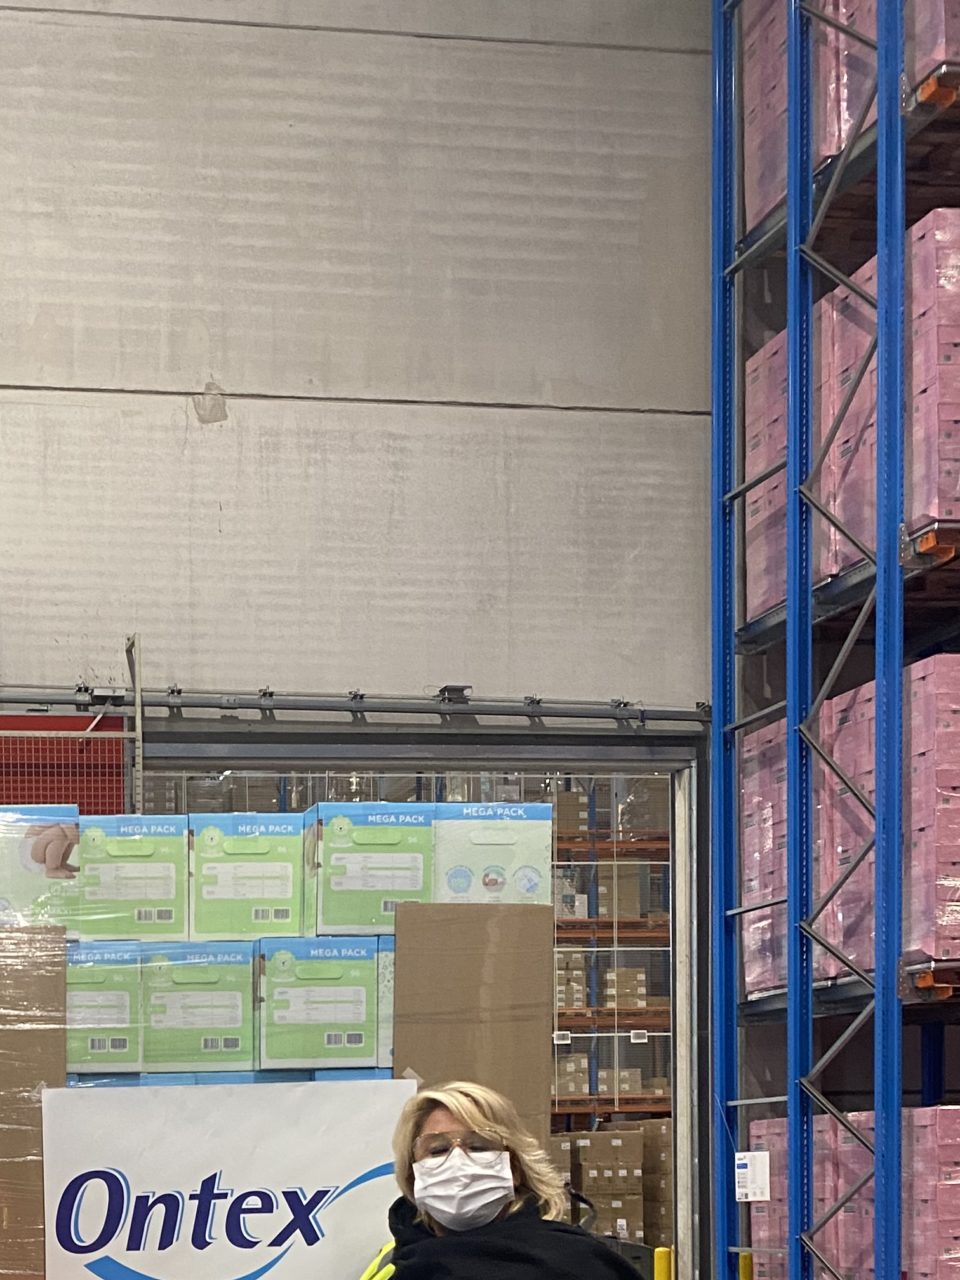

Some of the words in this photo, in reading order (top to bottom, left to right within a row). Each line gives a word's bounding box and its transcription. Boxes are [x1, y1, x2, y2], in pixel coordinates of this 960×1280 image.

[463, 807, 492, 816] MEGA
[497, 807, 525, 816] PACK
[368, 814, 396, 823] MEGA
[399, 814, 425, 823] PACK
[120, 825, 146, 834] MEGA
[149, 825, 176, 833] PACK
[238, 825, 266, 834] MEGA
[269, 825, 294, 833] PACK
[73, 953, 101, 961] MEGA
[104, 952, 131, 961] PACK
[310, 949, 338, 957] MEGA
[341, 948, 367, 957] PACK
[187, 954, 214, 962] MEGA
[217, 953, 242, 962] PACK
[55, 1167, 339, 1255] Ontex
